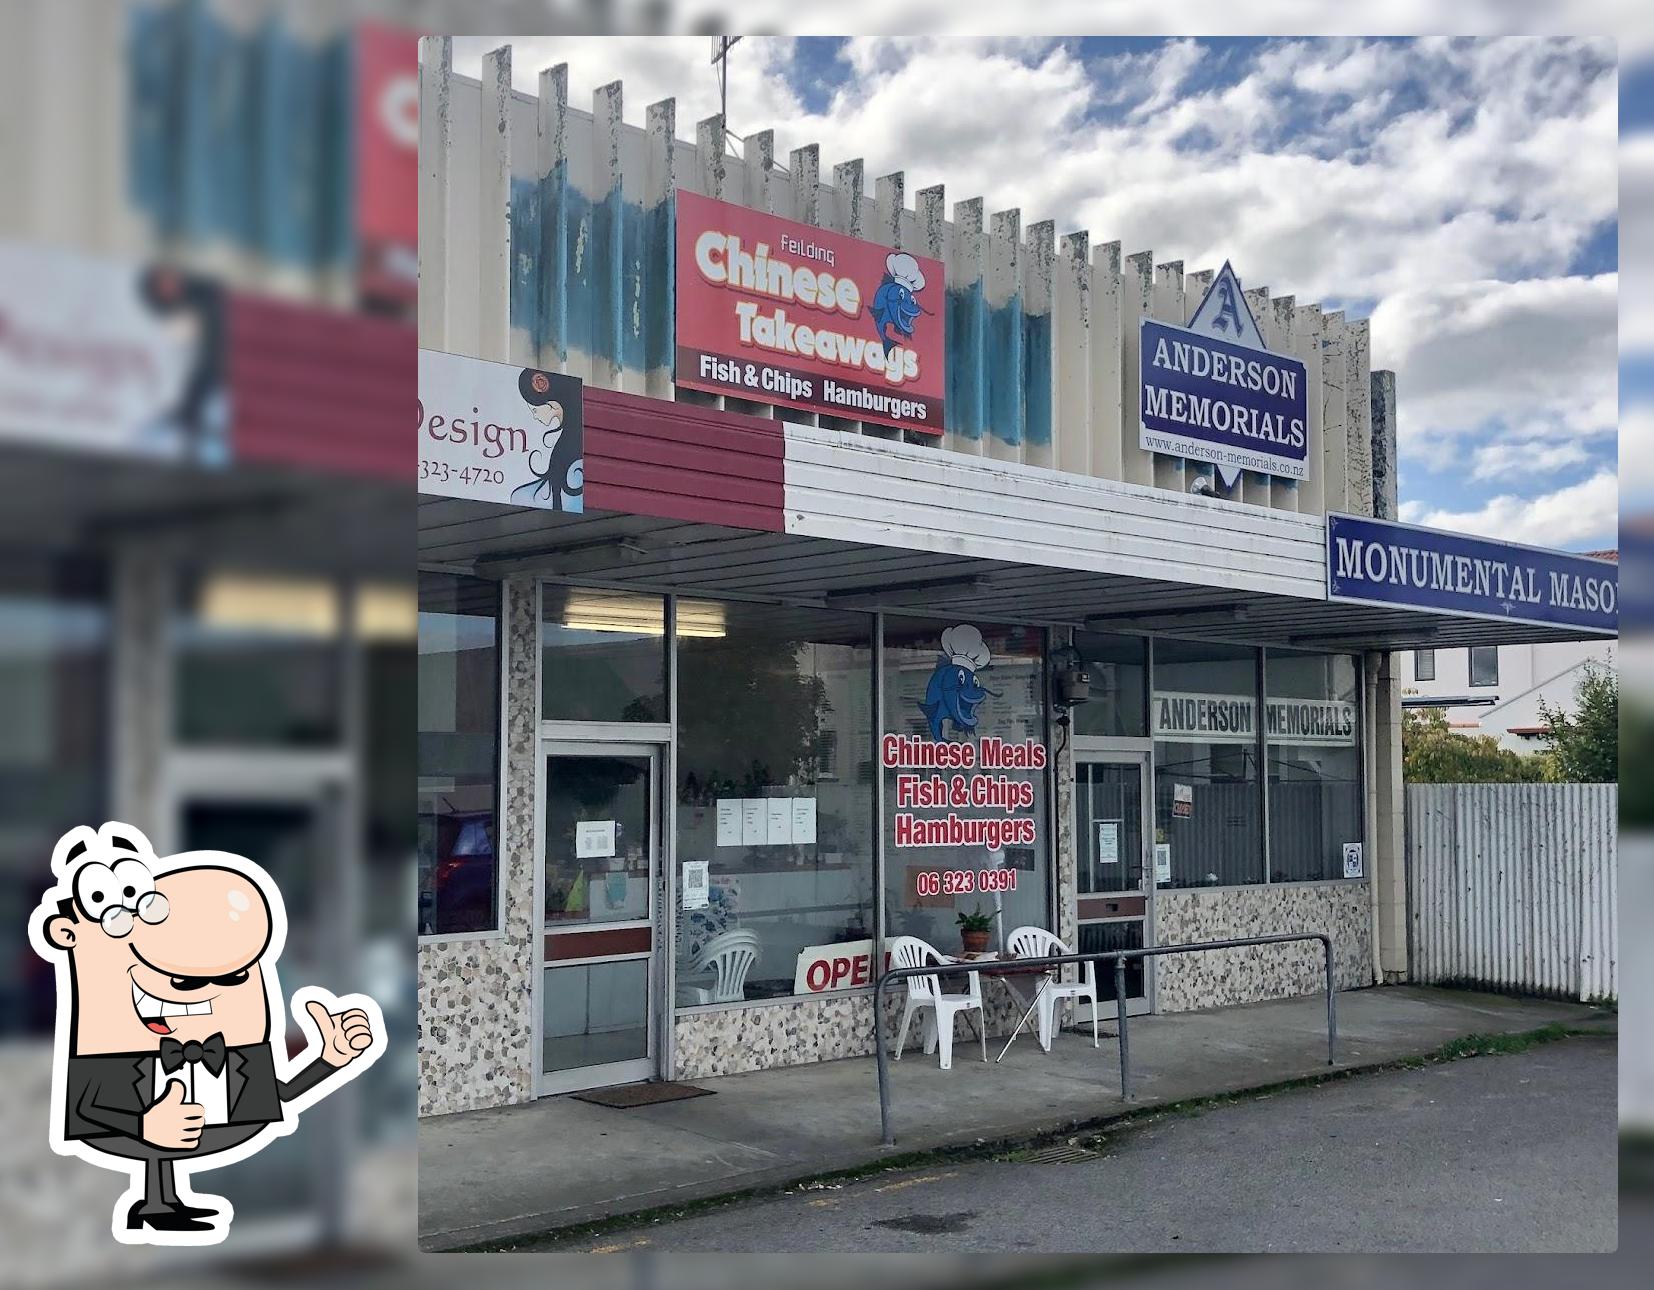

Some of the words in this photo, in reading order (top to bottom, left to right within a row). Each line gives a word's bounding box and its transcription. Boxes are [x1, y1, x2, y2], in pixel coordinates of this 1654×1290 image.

[695, 230, 861, 317] Chinese
[735, 301, 920, 383] Takeaways
[1152, 338, 1297, 400] ANDERSON
[700, 354, 740, 385] Fish
[743, 364, 759, 388] &
[761, 367, 813, 399] Chips
[823, 379, 928, 420] Hamburgers
[1145, 385, 1305, 448] MEMORIALS
[418, 397, 529, 459] esign
[1145, 435, 1304, 477] www.anderson-memorials.co.nz
[1336, 537, 1541, 604] MONUMENTAL
[1549, 571, 1618, 614] MASO
[1159, 697, 1251, 733] ANDERSON
[1265, 703, 1352, 736] MEMORIALS
[882, 733, 975, 768] Chinese
[980, 736, 1046, 769] Meals
[897, 775, 948, 808] Fish
[949, 775, 969, 808] &
[971, 775, 1033, 813] Chips
[895, 813, 1036, 850] Hamburgers
[917, 872, 940, 896] 06
[943, 870, 975, 894] 323
[979, 868, 1017, 892] 0391
